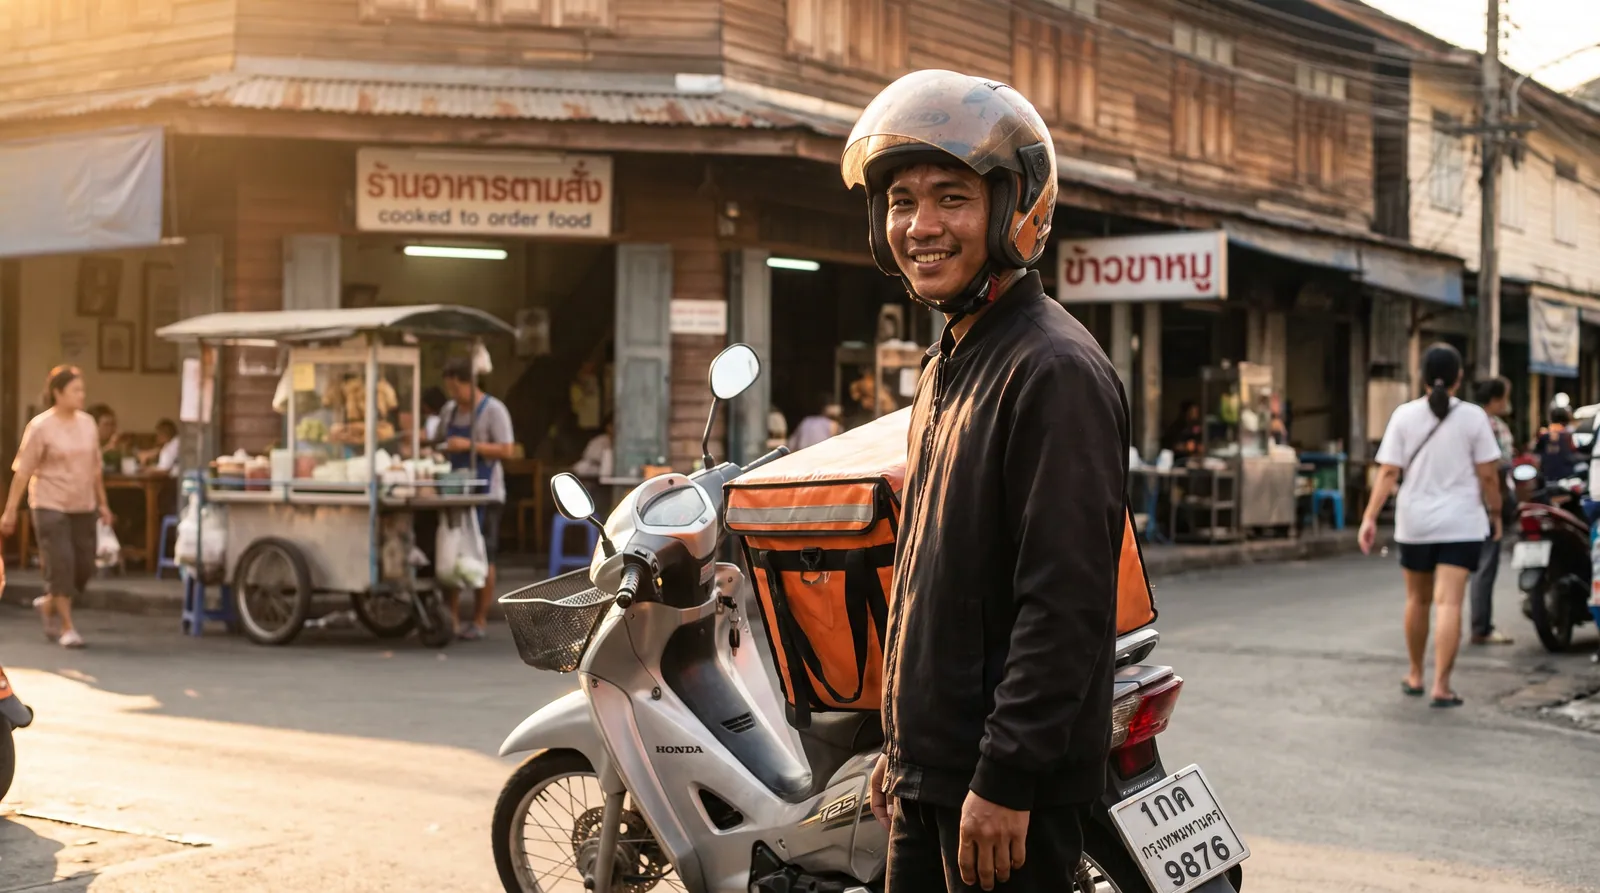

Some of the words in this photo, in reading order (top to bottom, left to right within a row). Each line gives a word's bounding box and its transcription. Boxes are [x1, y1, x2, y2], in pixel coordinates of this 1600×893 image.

[367, 160, 603, 204] ร้านอาหารตามสั่ง
[378, 207, 452, 225] cooked
[460, 209, 479, 226] to
[487, 209, 539, 227] order
[548, 211, 592, 229] food
[1065, 245, 1212, 292] ข้าวขาหมู
[655, 745, 704, 754] HONDA
[820, 794, 857, 824] 125
[1140, 786, 1195, 827] 1กค
[1141, 809, 1222, 860] กรุงเทพมหานคร
[1164, 835, 1231, 887] 9876
